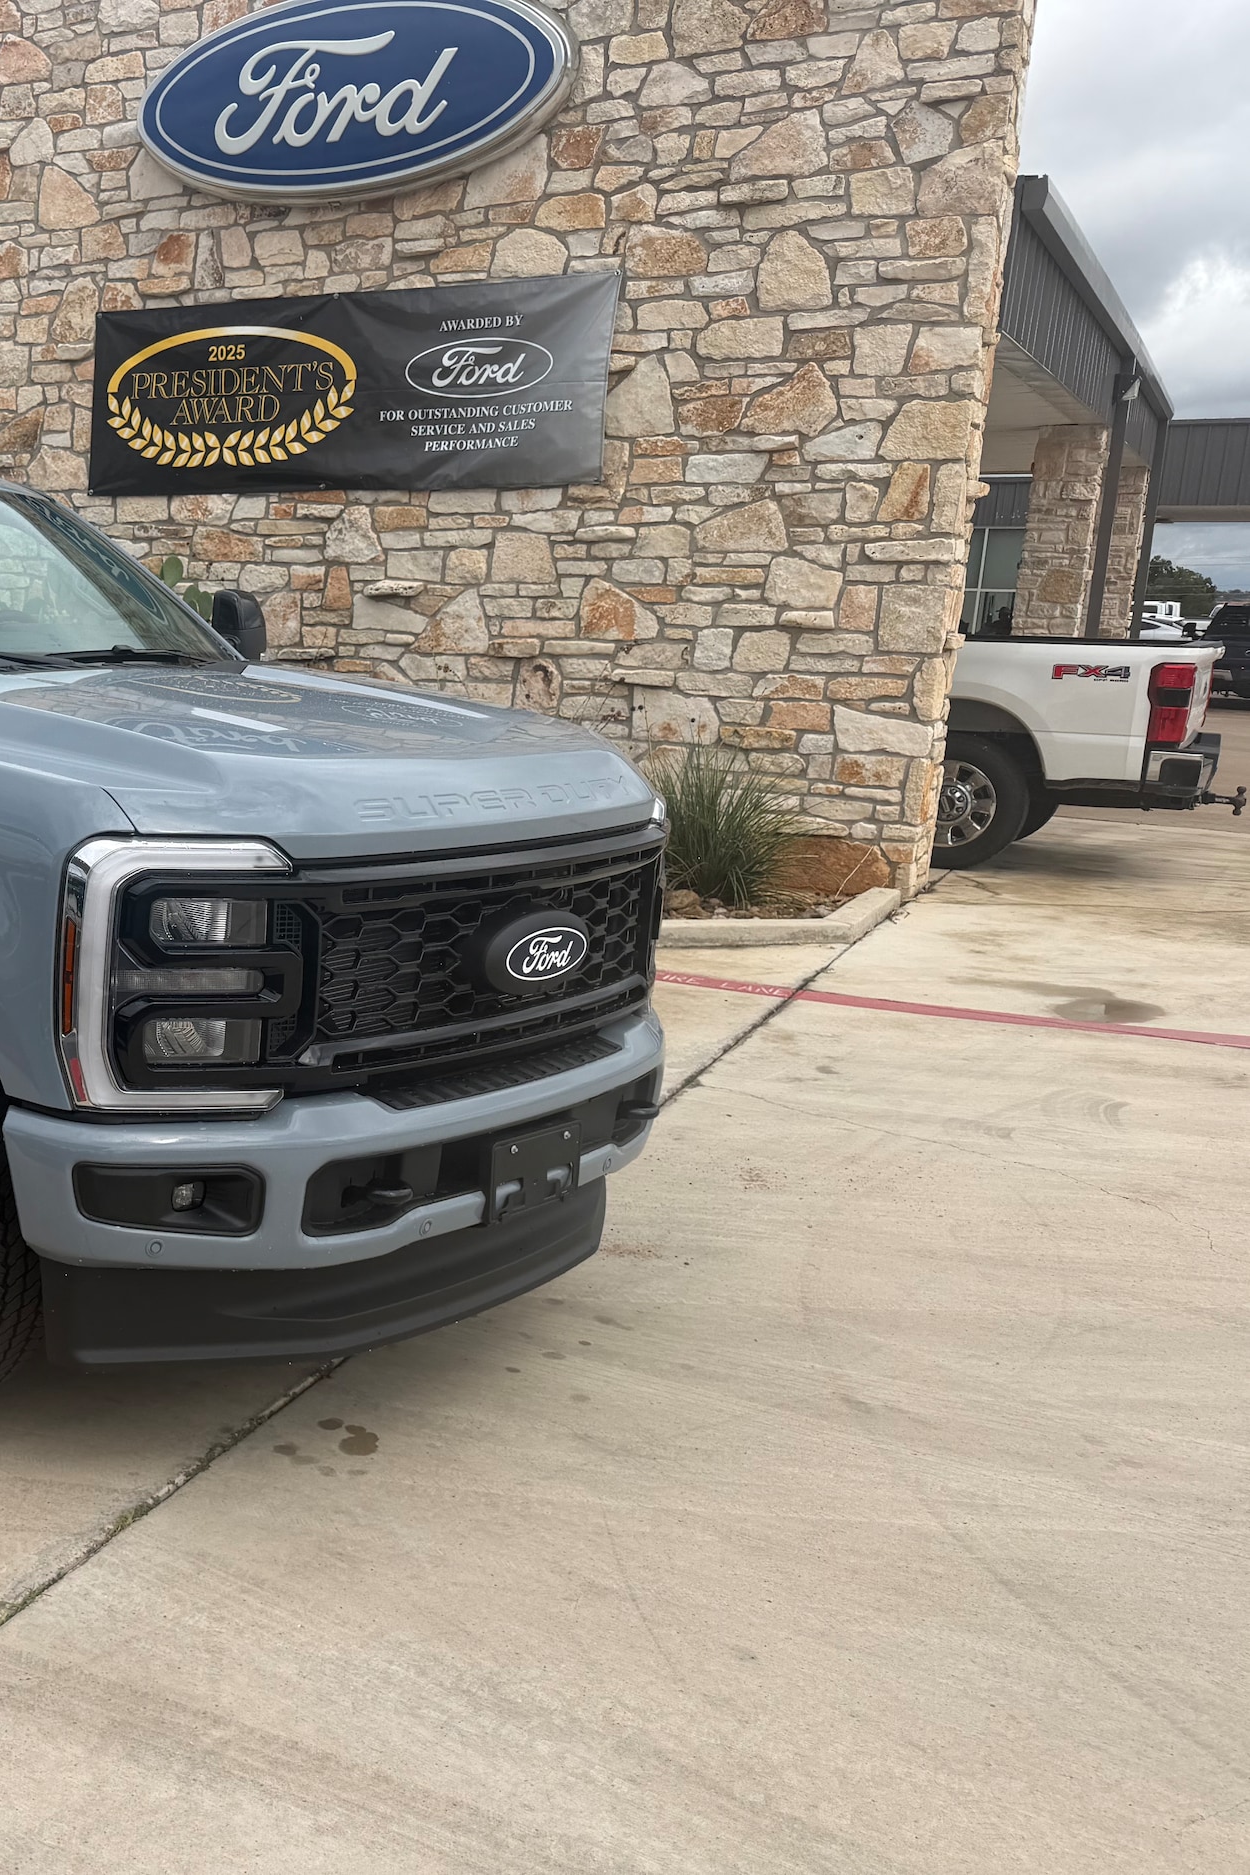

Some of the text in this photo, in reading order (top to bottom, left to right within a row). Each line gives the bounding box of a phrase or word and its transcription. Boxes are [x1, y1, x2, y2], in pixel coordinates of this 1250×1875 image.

[214, 30, 459, 156] Ford
[438, 313, 524, 332] AWARDED BY
[207, 344, 246, 362] 2025
[431, 345, 526, 388] Ford
[130, 360, 335, 400] PRESIDENT'S
[169, 394, 281, 426] AWARD
[379, 400, 574, 422] FOR OUTSTANDING CUSTOMER
[410, 418, 536, 437] SERVICE AND SALES
[424, 435, 519, 452] PERFORMANCE
[1052, 663, 1131, 680] FX4
[353, 775, 630, 823] SUPER DUTY
[522, 934, 575, 975] Ford
[718, 981, 789, 999] LANE
